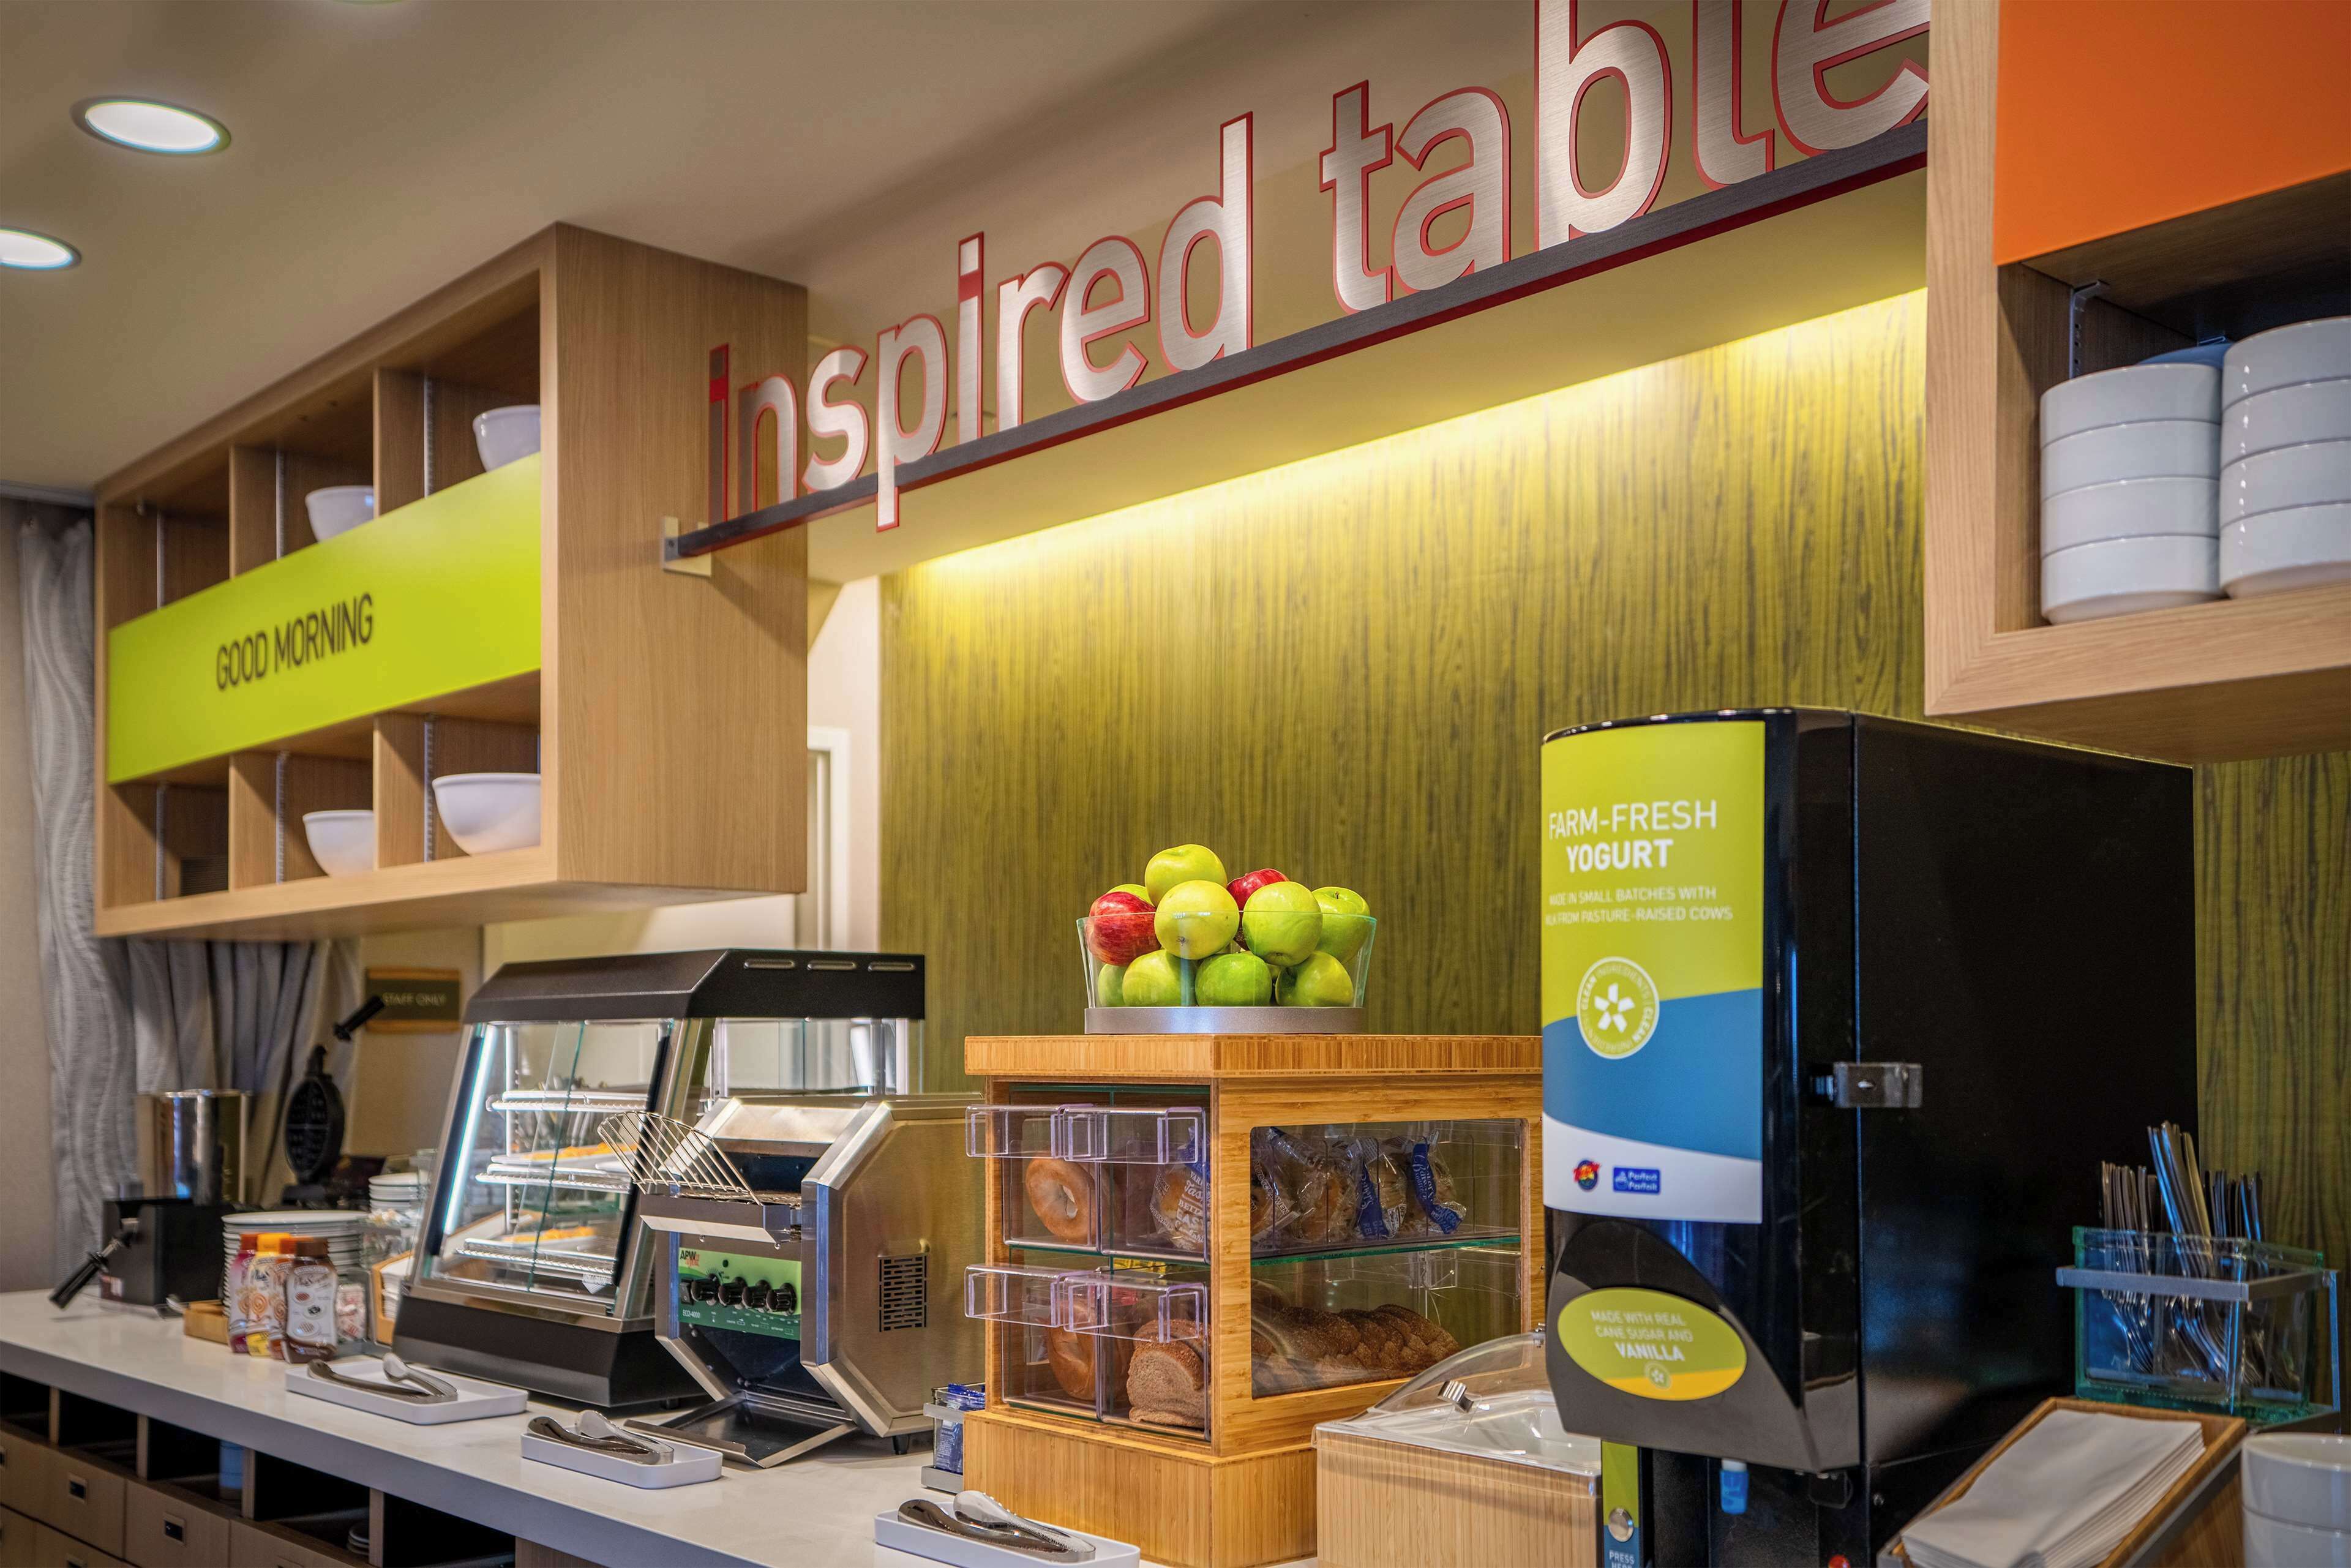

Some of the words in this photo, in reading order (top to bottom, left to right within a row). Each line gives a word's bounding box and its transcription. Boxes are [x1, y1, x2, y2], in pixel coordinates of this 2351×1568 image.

[708, 111, 1253, 532] inspired
[1319, 0, 1928, 313] table
[216, 629, 268, 691] GOOD
[274, 592, 373, 674] MORNING
[1549, 800, 1717, 839] FARM-FRESH
[1566, 838, 1674, 873] YOGURT
[1567, 892, 1577, 904] IN
[1578, 890, 1612, 904] SMALL
[1616, 885, 1676, 902] BATCHES
[1678, 885, 1717, 901] WITH
[1558, 910, 1580, 925] FROM
[1689, 905, 1733, 921] COWS
[382, 992, 414, 1006] STAFF
[415, 992, 448, 1007] ONLY
[1581, 974, 1597, 1010] CLEAN
[1632, 1007, 1654, 1042] CLEAN
[680, 1250, 696, 1260] APW
[1591, 1310, 1623, 1322] MADE
[1624, 1311, 1652, 1324] WITH
[1654, 1313, 1686, 1326] REAL
[1595, 1325, 1624, 1338] CANE
[1627, 1327, 1666, 1341] SUGAR
[1668, 1330, 1693, 1343] AND
[1614, 1342, 1685, 1362] VANILLA
[1609, 1549, 1635, 1565] PRESS
